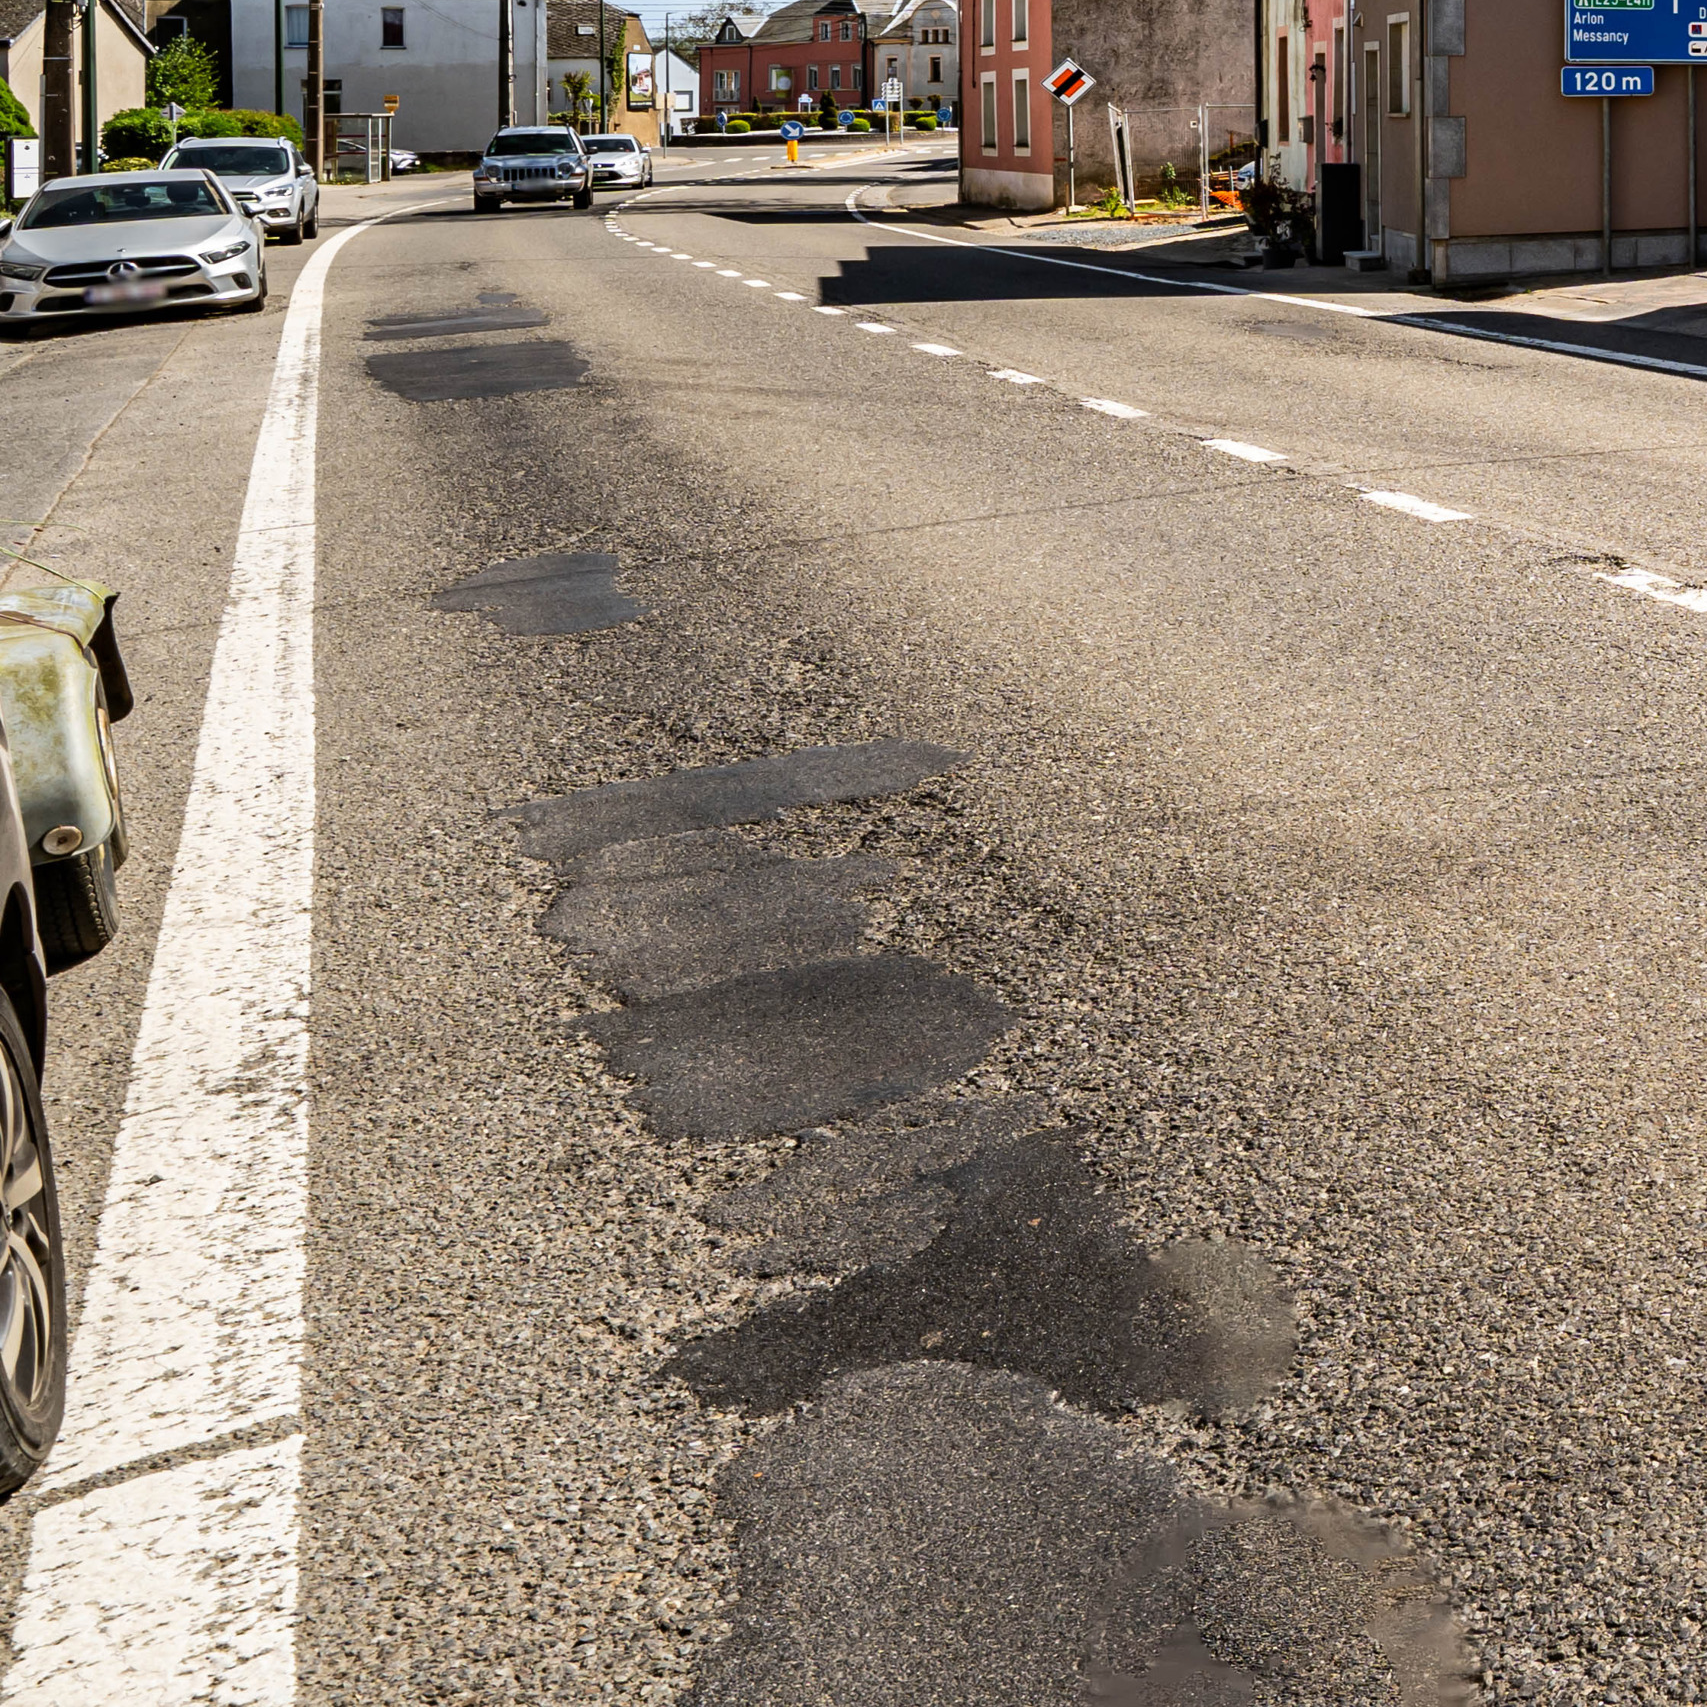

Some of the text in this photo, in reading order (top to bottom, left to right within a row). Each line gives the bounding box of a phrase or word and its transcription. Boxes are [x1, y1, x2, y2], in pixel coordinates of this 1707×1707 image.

[1574, 12, 1604, 25] Arlon
[1574, 29, 1629, 45] Messancy
[1575, 72, 1641, 91] 120 m
